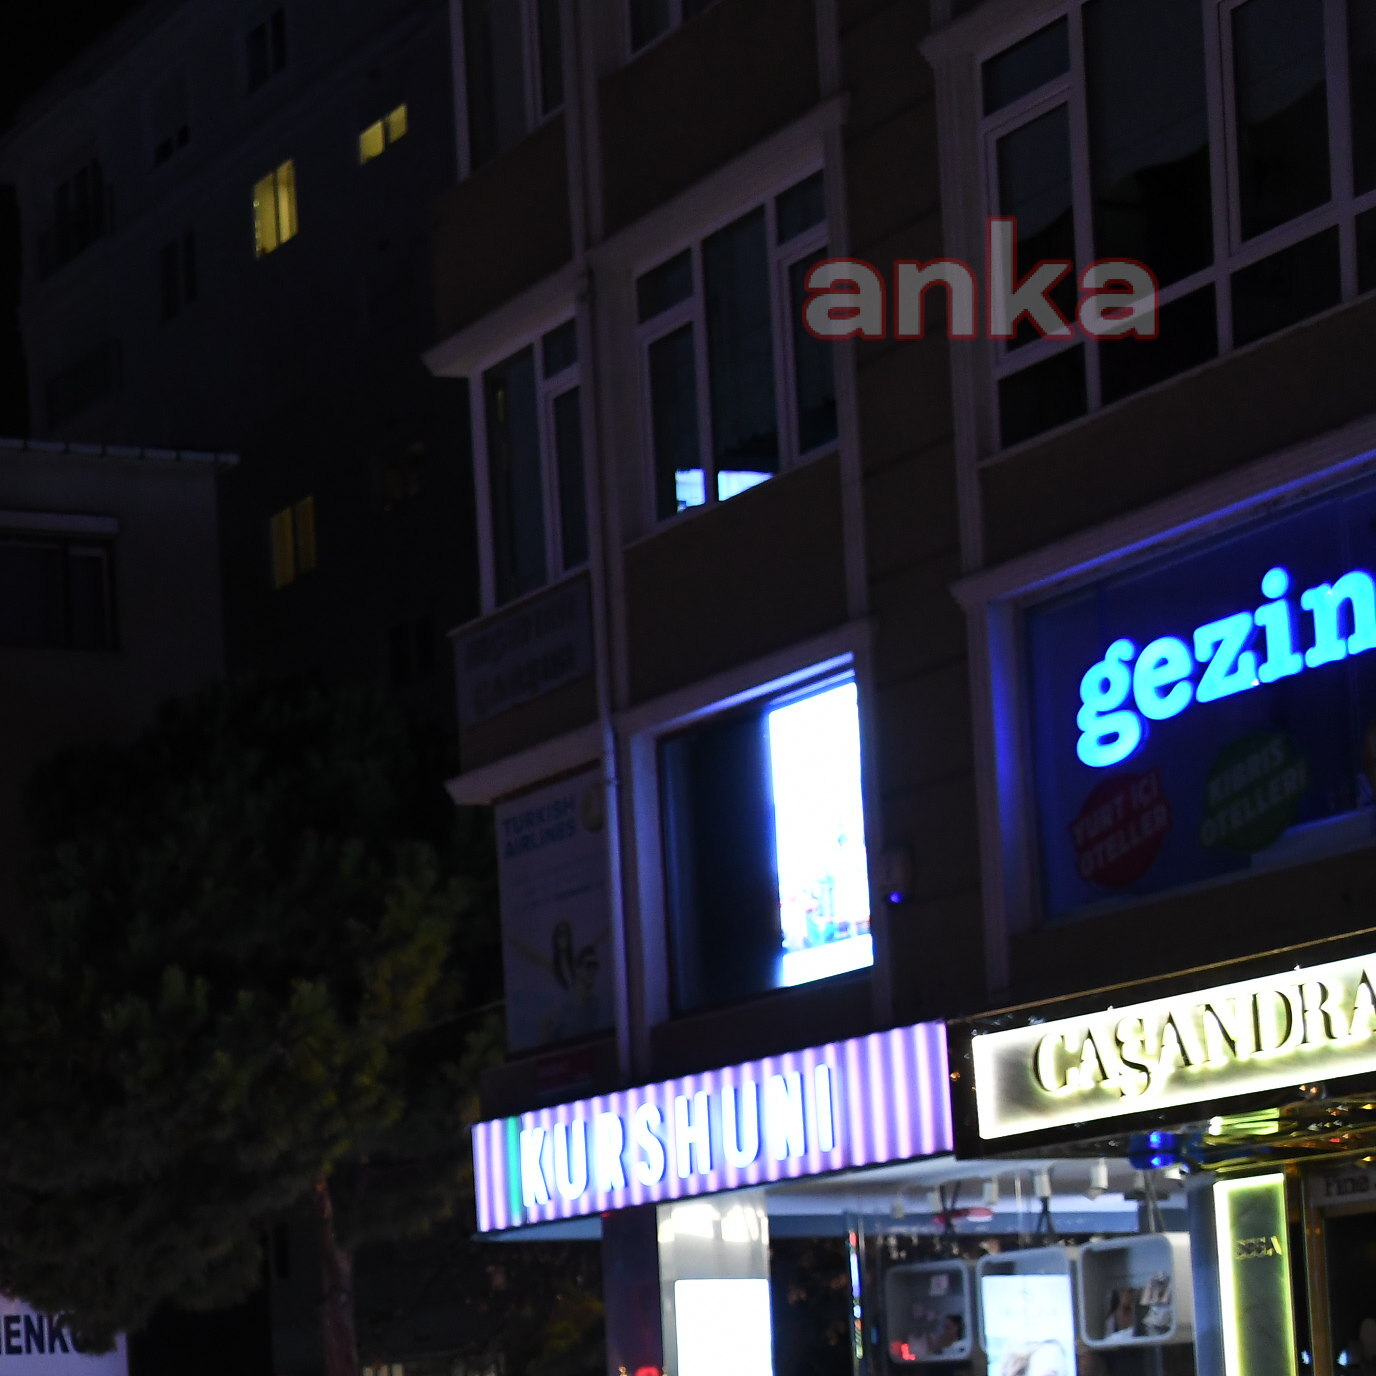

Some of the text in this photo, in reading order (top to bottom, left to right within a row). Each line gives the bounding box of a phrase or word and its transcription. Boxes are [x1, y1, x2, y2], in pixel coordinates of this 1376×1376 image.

[1076, 566, 1376, 769] gezin
[1079, 803, 1169, 879] OTELLER
[519, 1063, 834, 1208] KURSHUNI
